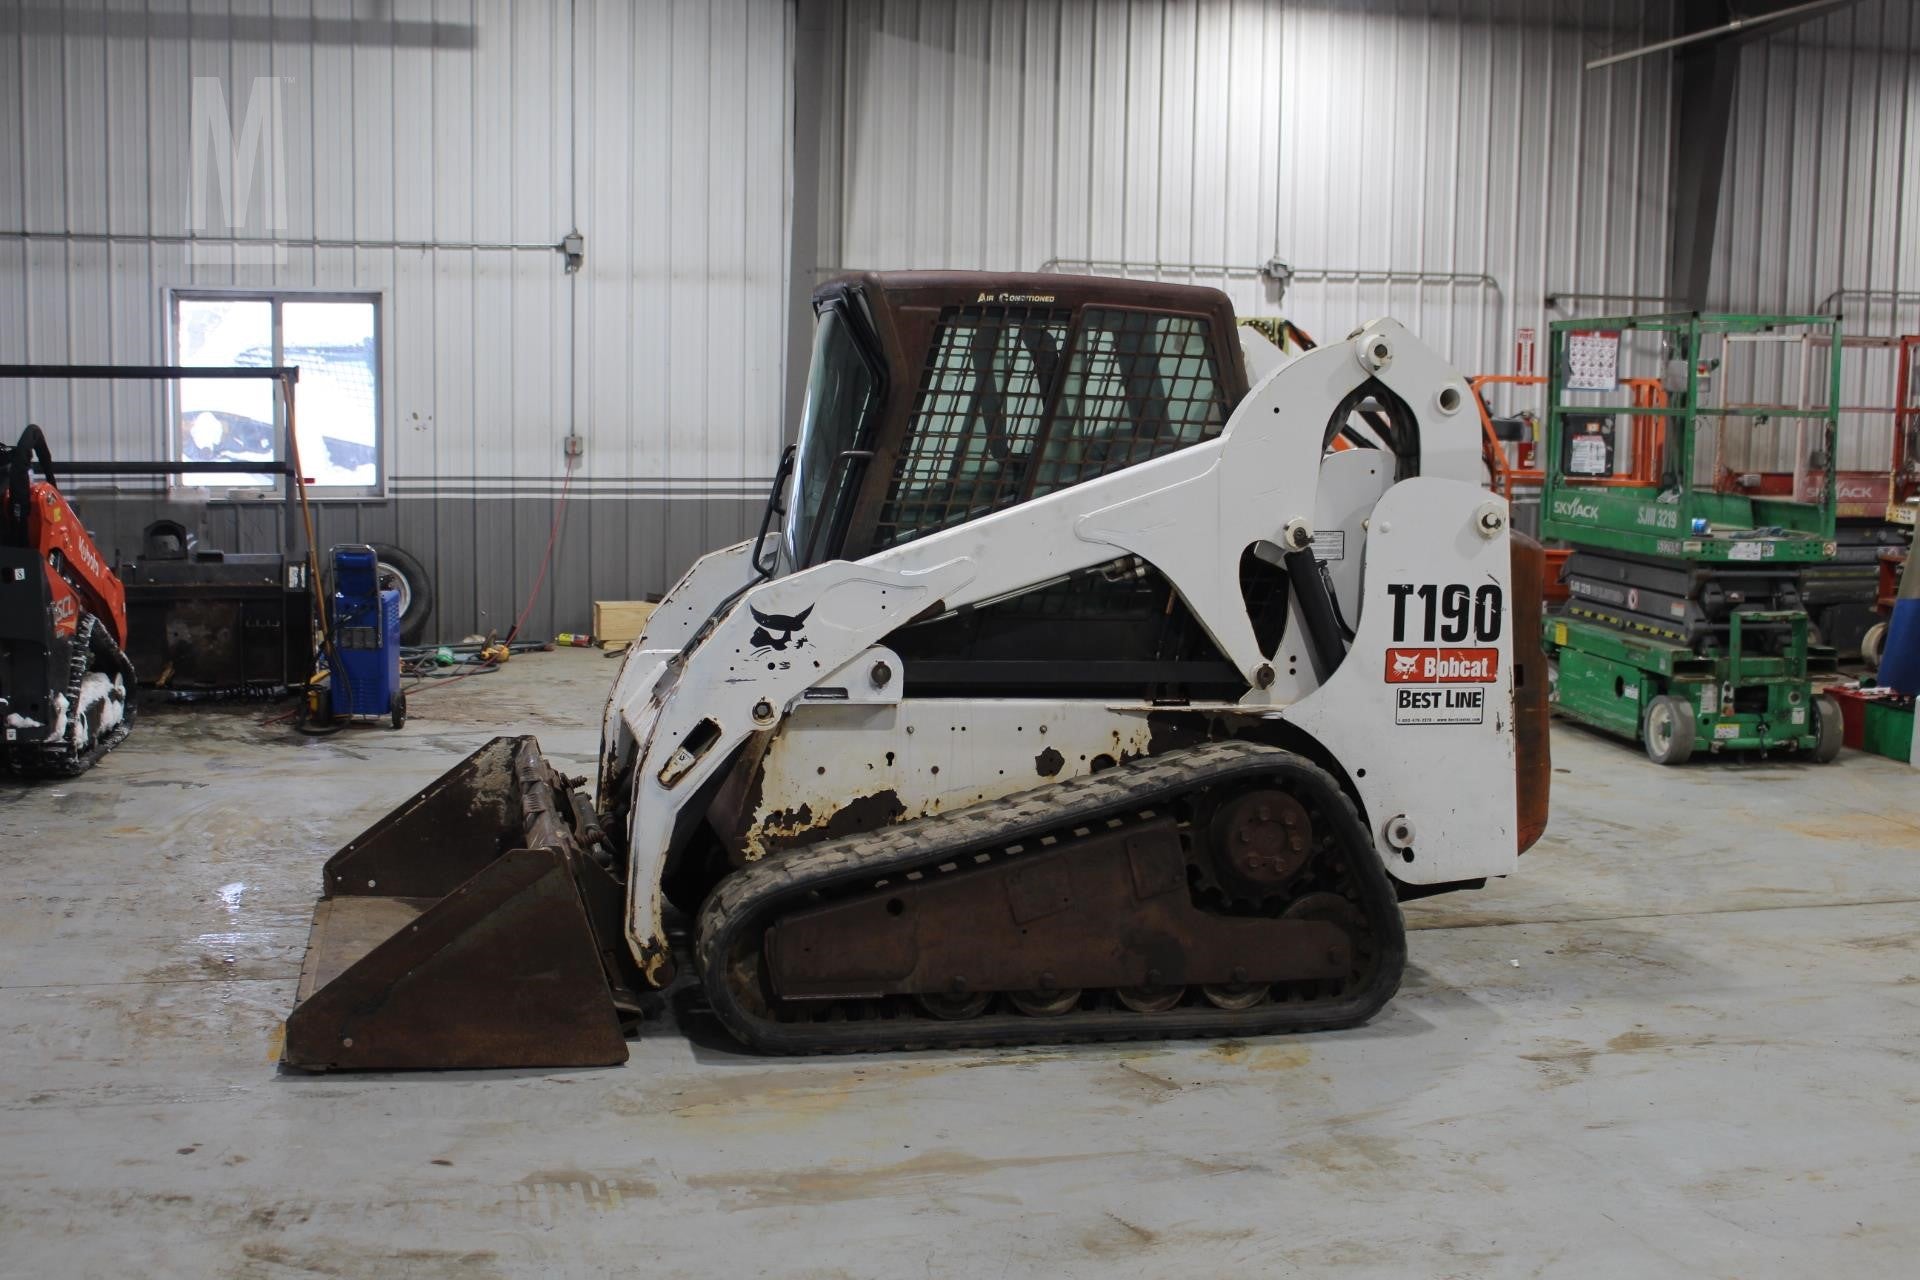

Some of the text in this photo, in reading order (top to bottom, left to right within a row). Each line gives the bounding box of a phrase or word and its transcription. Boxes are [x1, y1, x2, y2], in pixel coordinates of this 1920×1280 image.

[977, 292, 994, 302] AIR
[1806, 481, 1873, 500] SKJACK
[1553, 497, 1600, 520] SKYJACK
[1387, 584, 1502, 643] T190
[1424, 657, 1489, 678] Bobcat
[1399, 690, 1482, 708] BEST LINE
